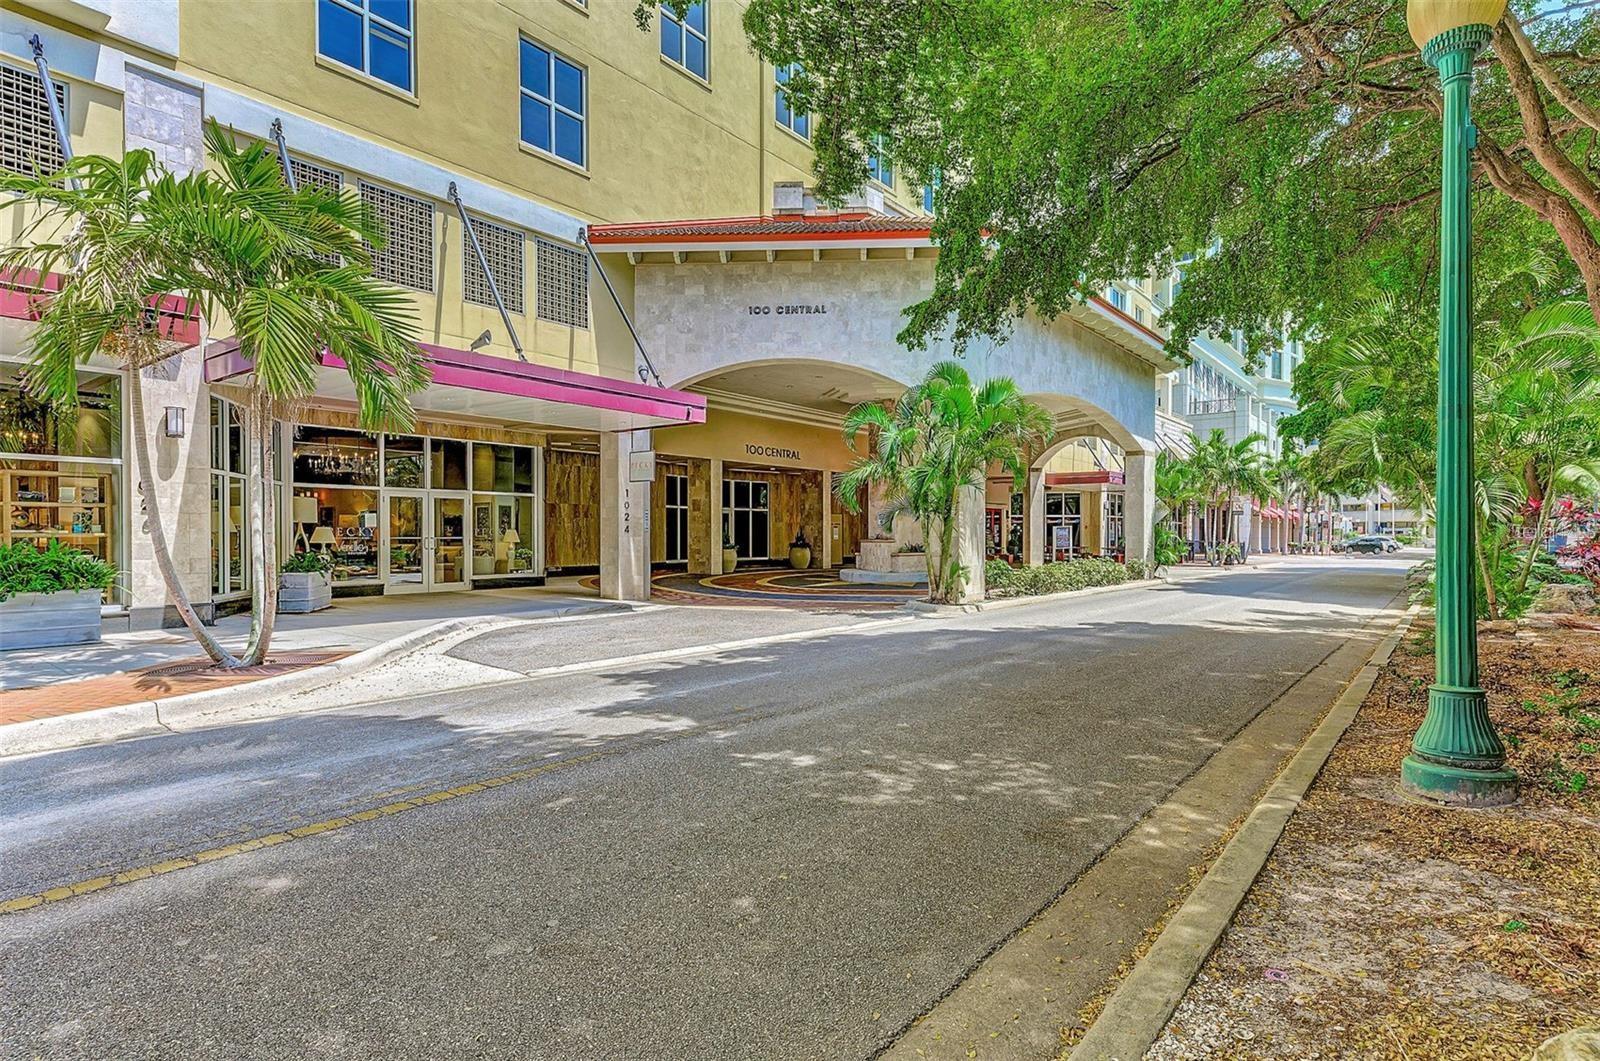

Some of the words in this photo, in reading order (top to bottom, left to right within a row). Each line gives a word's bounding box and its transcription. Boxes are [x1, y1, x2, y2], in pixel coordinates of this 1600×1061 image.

[748, 306, 771, 315] 100
[775, 305, 827, 315] CENTRAL
[745, 444, 764, 455] 100
[765, 447, 801, 460] CENTRAL
[328, 527, 375, 536] ECKY
